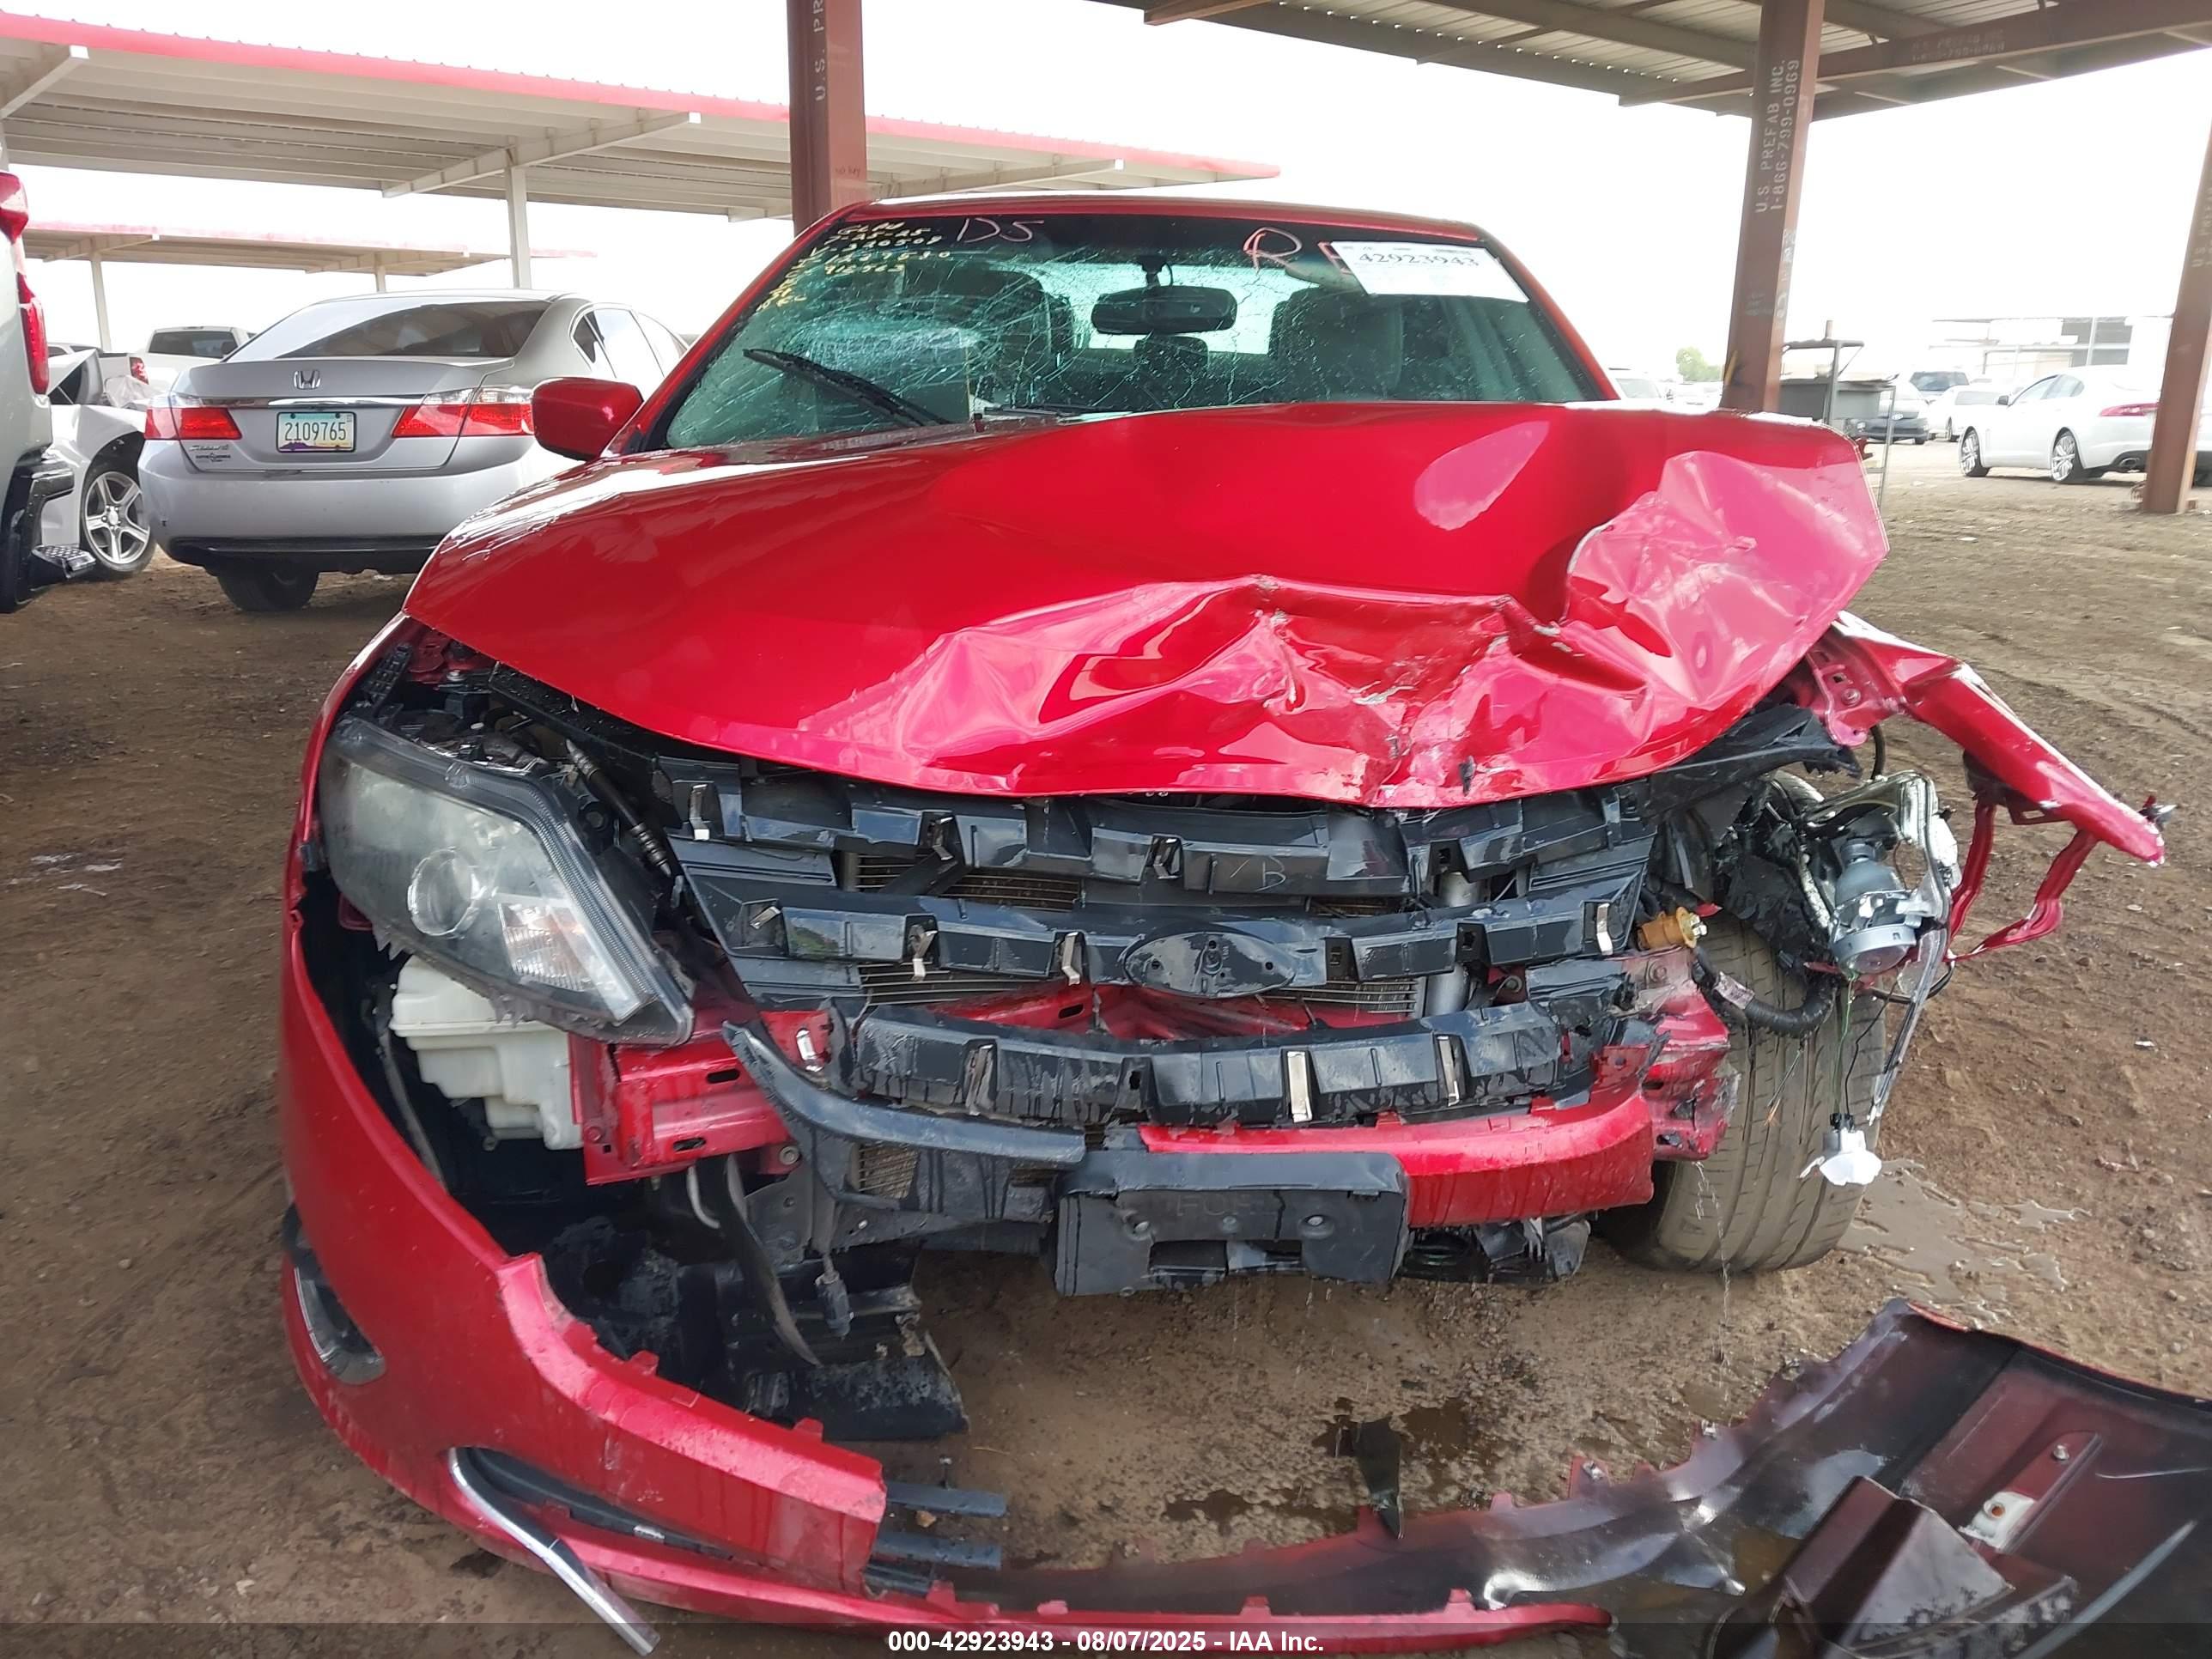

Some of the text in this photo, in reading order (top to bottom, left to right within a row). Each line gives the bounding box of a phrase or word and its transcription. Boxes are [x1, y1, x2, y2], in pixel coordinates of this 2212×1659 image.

[1760, 101, 1780, 171] PREFAB
[1770, 60, 1786, 94] INC.
[1771, 59, 1800, 210] 1-866-799-0969
[1358, 252, 1480, 267] 42923943
[284, 422, 347, 441] 2109765
